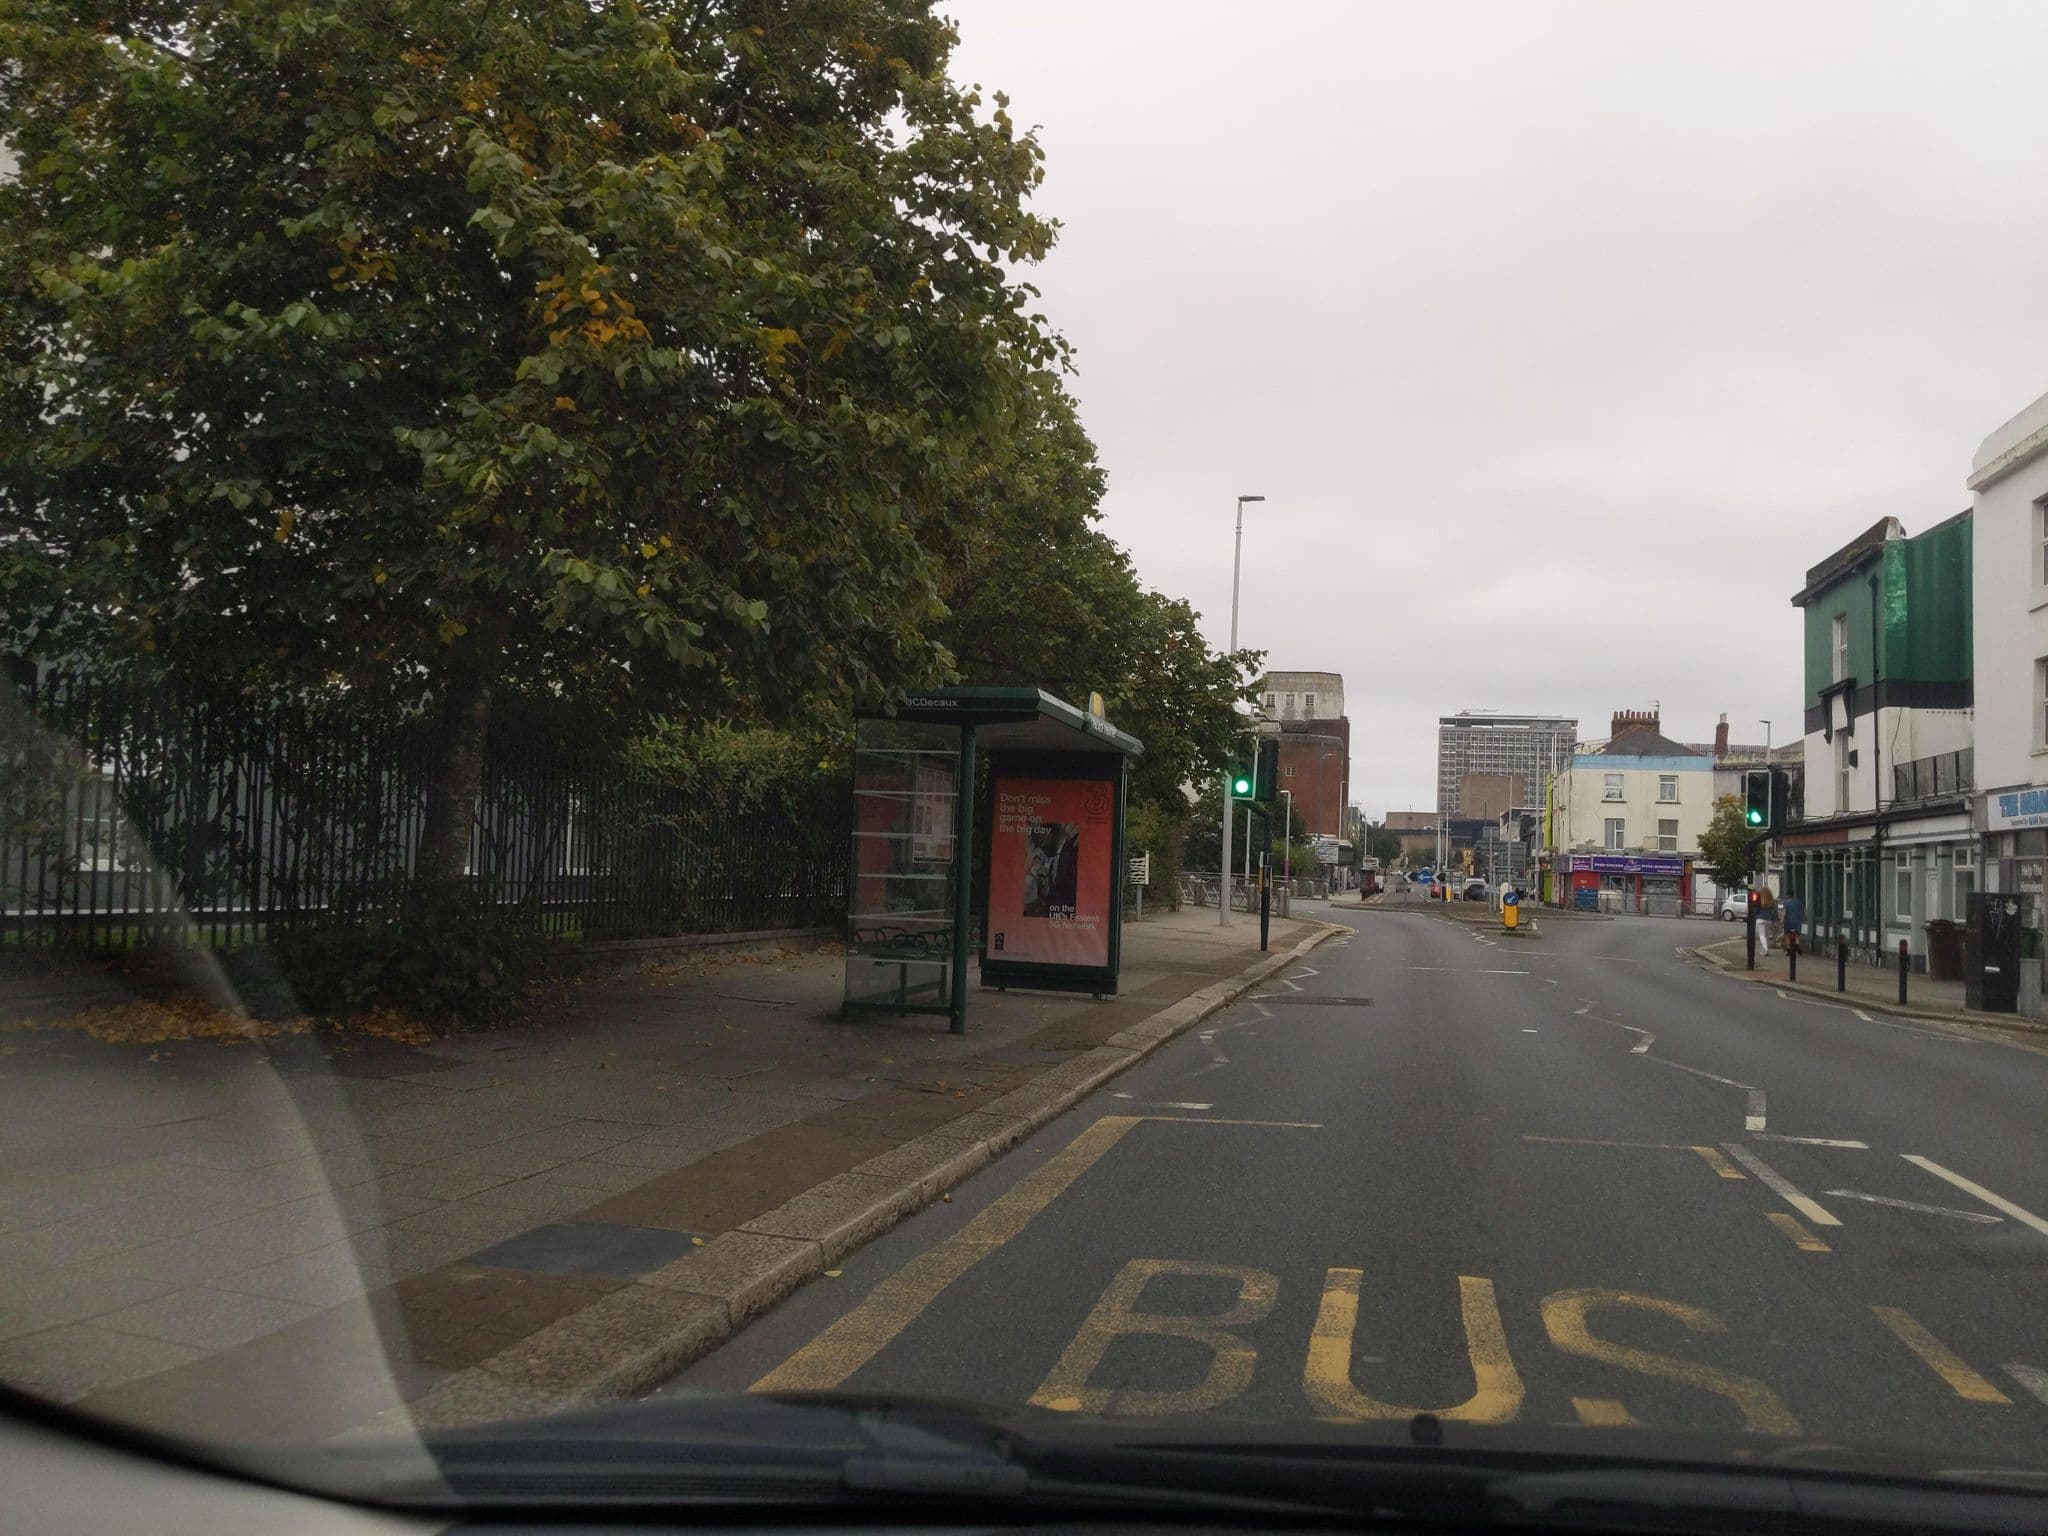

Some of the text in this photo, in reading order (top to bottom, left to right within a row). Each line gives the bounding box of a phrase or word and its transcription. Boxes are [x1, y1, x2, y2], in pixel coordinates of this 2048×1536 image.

[1000, 793, 1051, 804] Don't miss
[1000, 804, 1033, 815] the big
[999, 815, 1027, 824] game
[999, 824, 1051, 836] the big day
[1061, 904, 1075, 912] the
[1049, 912, 1099, 922] UK's Fastest
[1027, 1258, 1798, 1437] BUS
